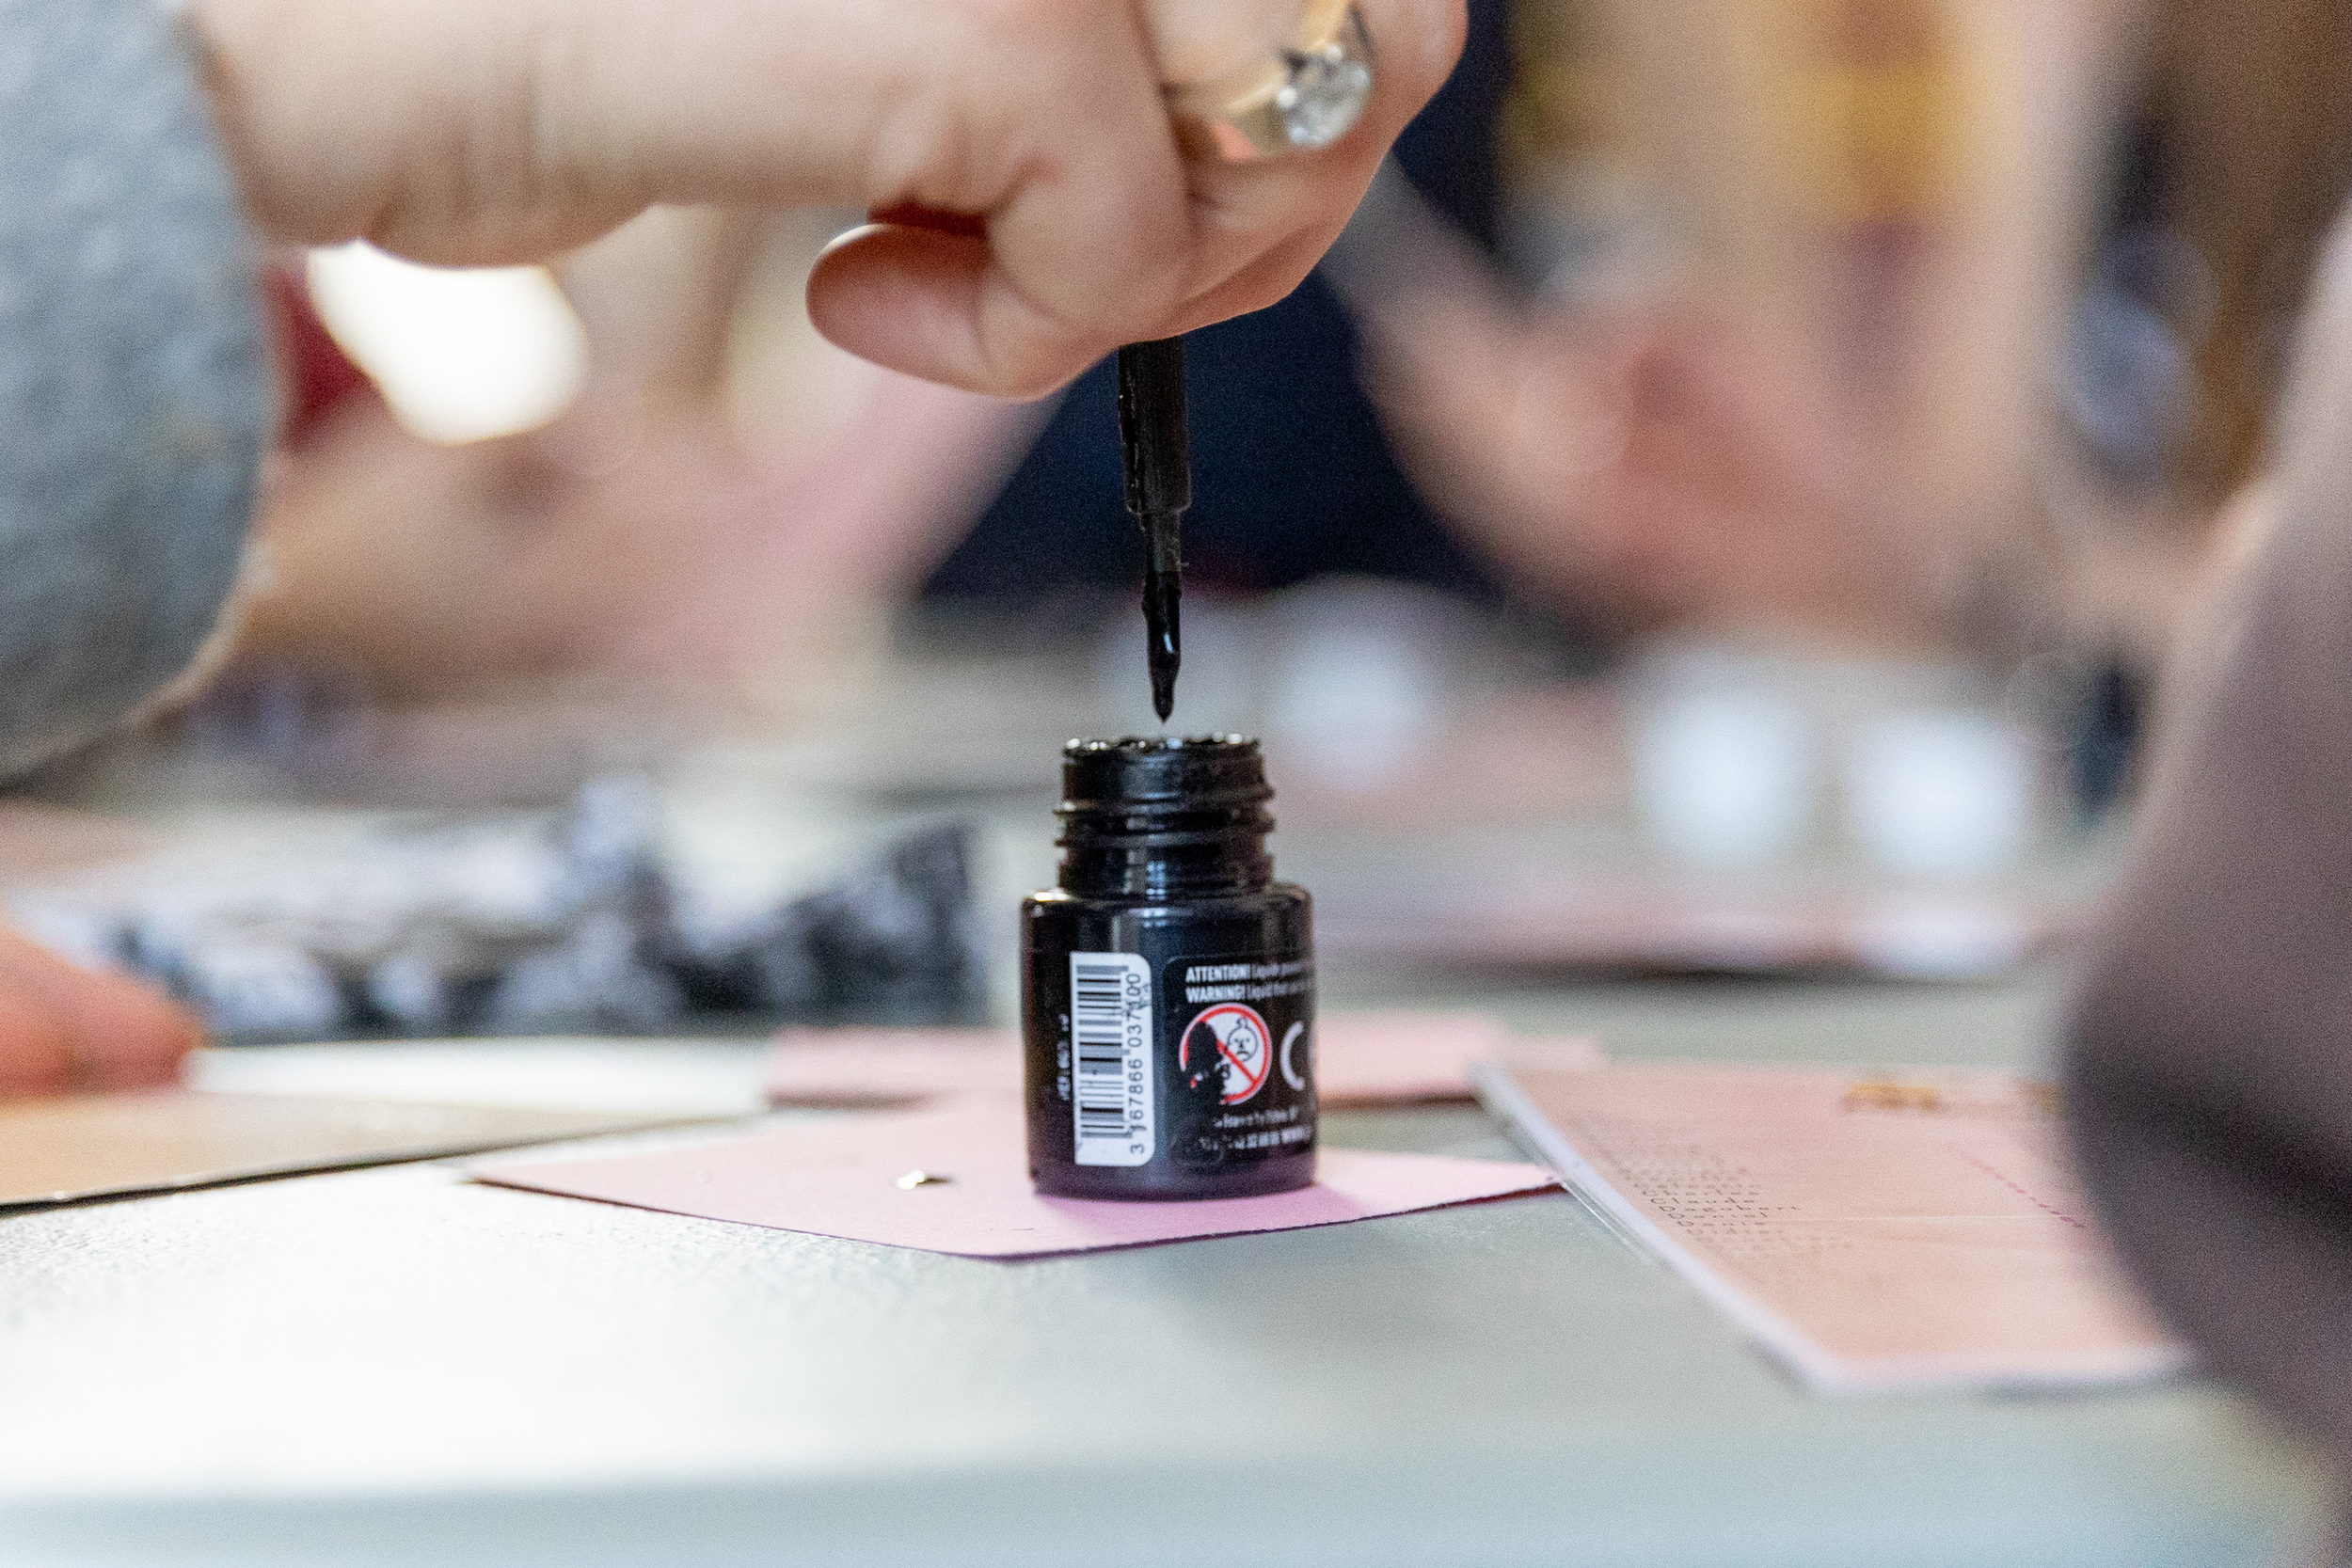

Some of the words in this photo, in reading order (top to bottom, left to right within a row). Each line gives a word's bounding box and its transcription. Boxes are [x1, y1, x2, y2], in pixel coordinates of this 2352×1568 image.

[1126, 973, 1142, 1048] 037100
[1127, 1058, 1145, 1132] 167866
[1130, 1143, 1144, 1155] 3
